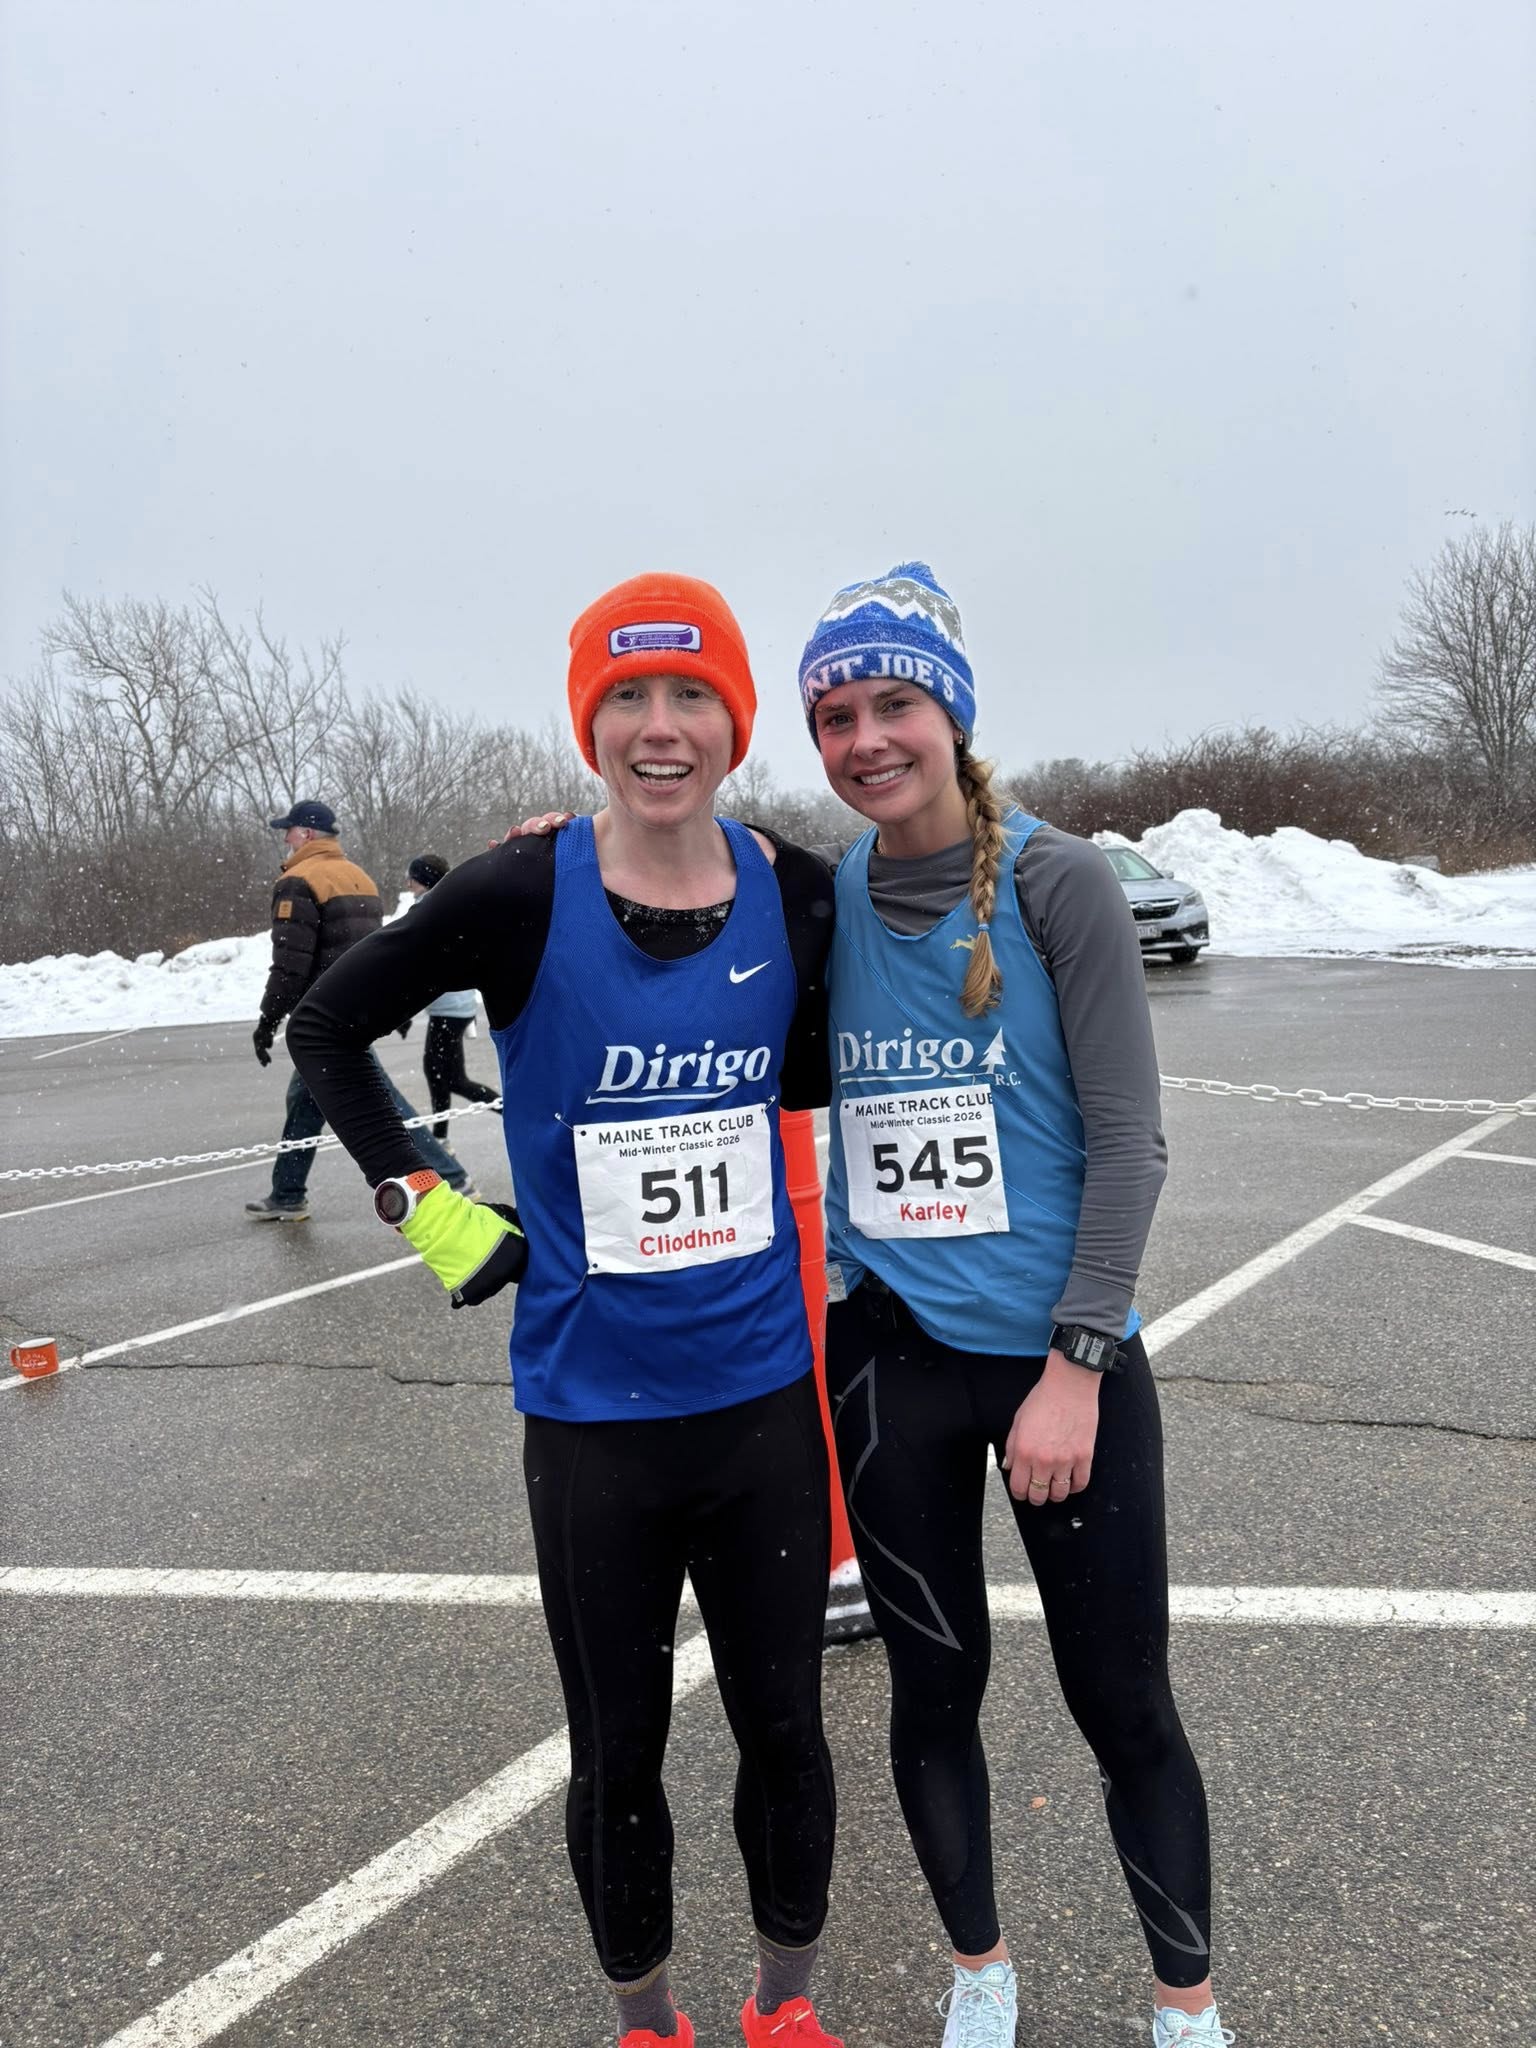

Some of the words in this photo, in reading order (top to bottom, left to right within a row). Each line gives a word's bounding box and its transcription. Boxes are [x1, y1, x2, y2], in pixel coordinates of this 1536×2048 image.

[868, 652, 955, 703] JOE'S
[594, 1039, 772, 1098] Dirigo
[838, 1027, 974, 1079] Dirigo
[995, 1072, 1021, 1086] R.C.
[855, 1101, 895, 1118] MAINE
[899, 1096, 951, 1113] TRACK
[870, 1118, 914, 1129] Mid-Winter
[917, 1114, 951, 1126] Classic
[954, 1111, 983, 1123] 2026
[598, 1128, 654, 1146] MAINE
[659, 1122, 713, 1141] TRACK
[719, 1114, 754, 1131] CLUB
[619, 1144, 676, 1158] Mid-Winter
[679, 1139, 714, 1152] Classic
[716, 1134, 740, 1147] 2026
[872, 1135, 994, 1194] 545
[641, 1160, 729, 1224] 511
[899, 1201, 968, 1224] Karley
[639, 1226, 737, 1257] Cliodhna
